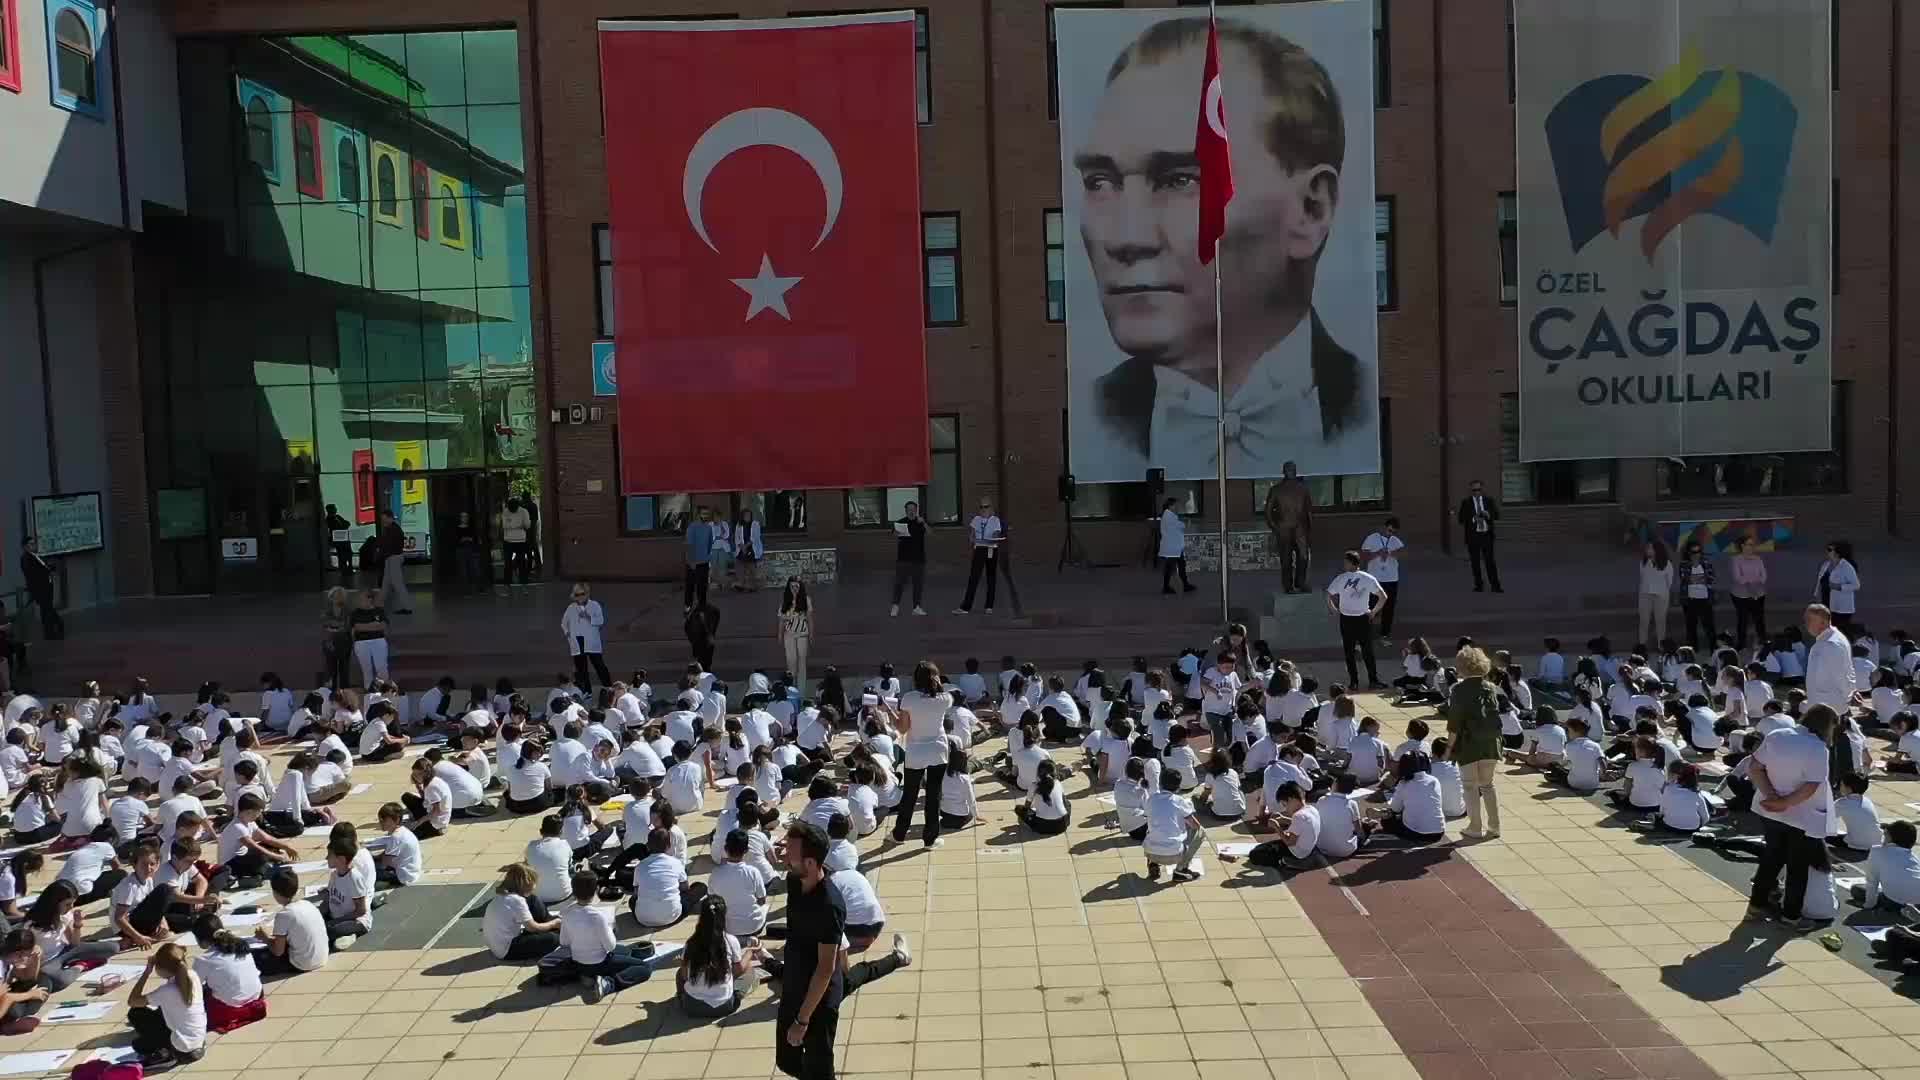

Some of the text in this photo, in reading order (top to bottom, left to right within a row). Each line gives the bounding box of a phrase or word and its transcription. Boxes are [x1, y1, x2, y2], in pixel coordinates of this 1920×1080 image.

[1536, 269, 1606, 294] ÖZEL
[1528, 289, 1821, 375] ÇAĞDAŞ
[1577, 370, 1771, 405] OKULLARI
